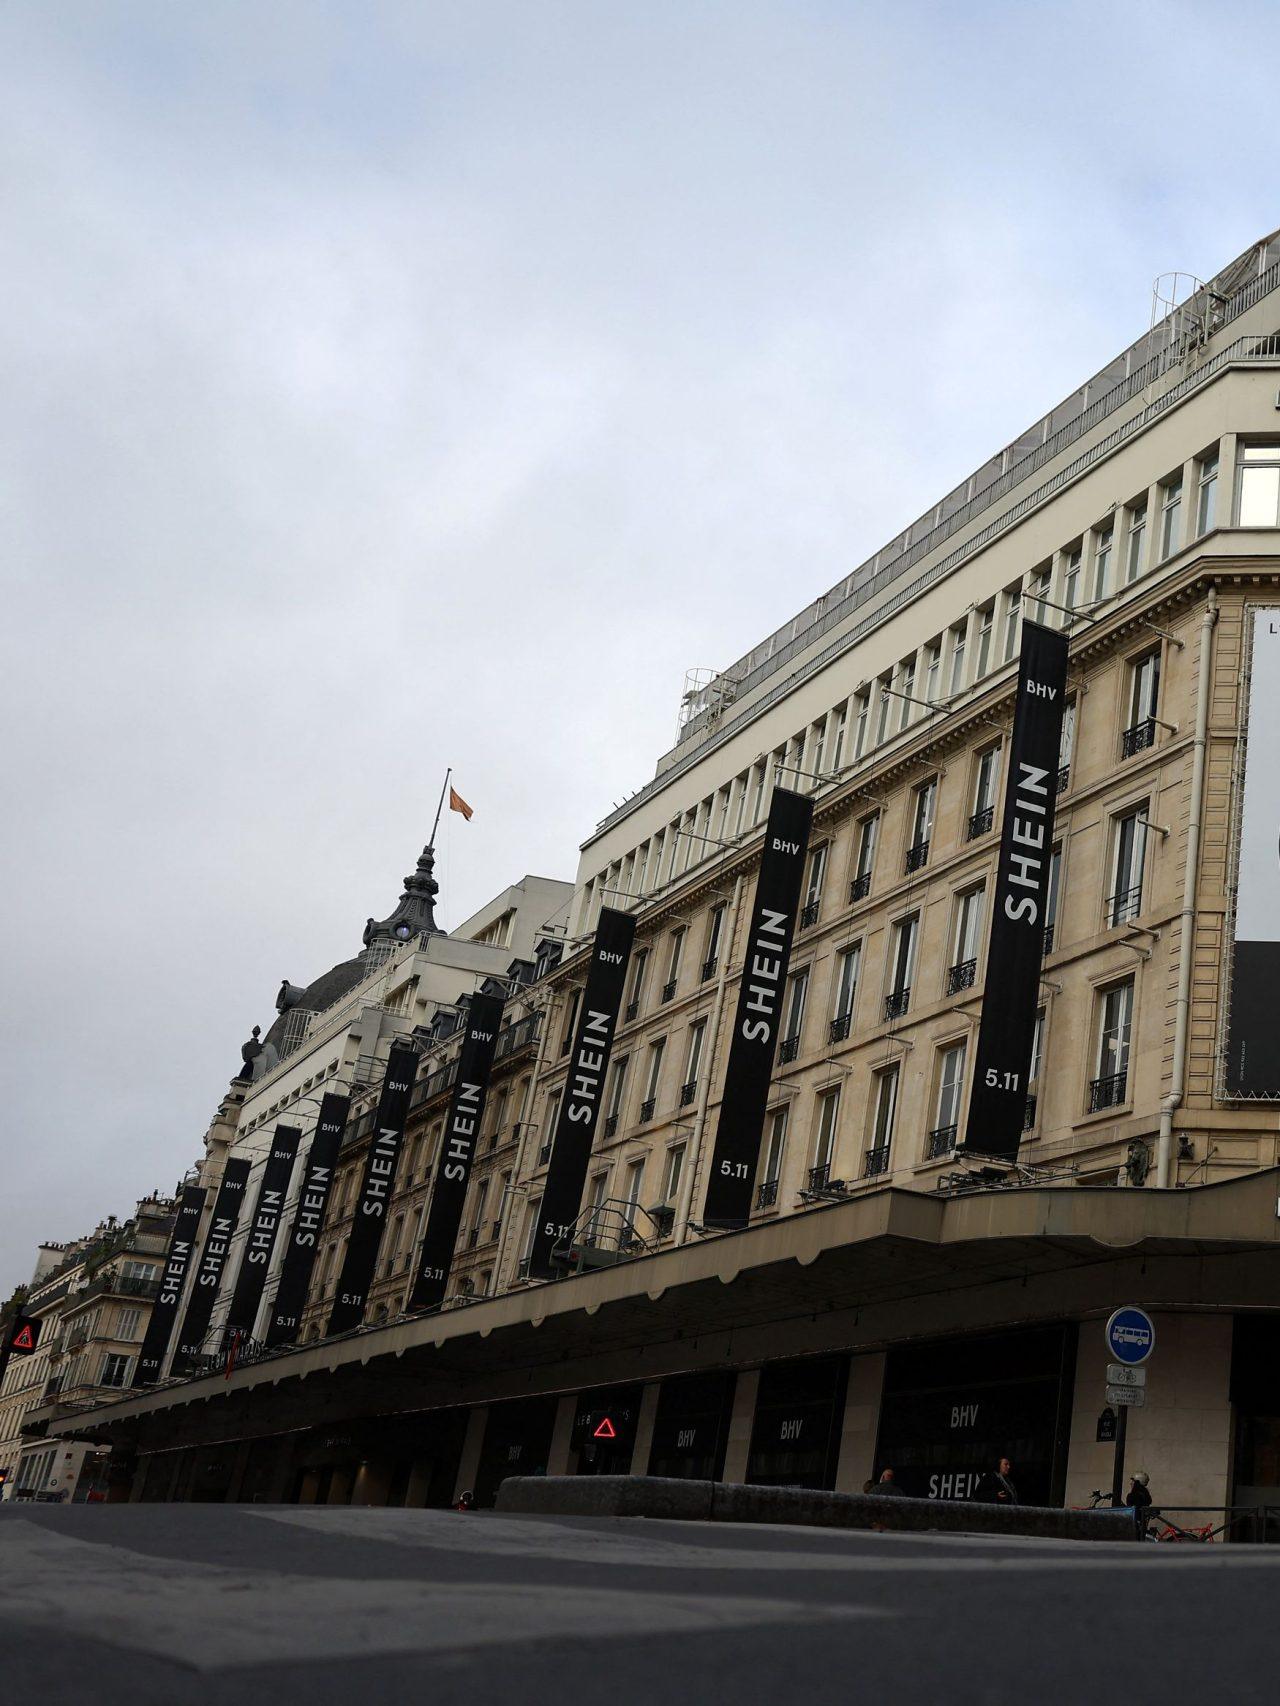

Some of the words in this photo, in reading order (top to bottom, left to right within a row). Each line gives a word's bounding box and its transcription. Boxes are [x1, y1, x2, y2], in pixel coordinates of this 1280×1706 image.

[1026, 678, 1057, 701] BHV
[771, 837, 800, 856] BHV
[1004, 762, 1050, 927] SHEIN
[598, 949, 623, 966] BHV
[741, 908, 789, 1044] SHEIN
[471, 1029, 493, 1043] BHV
[568, 1010, 612, 1124] SHEIN
[388, 1081, 408, 1093] BHV
[985, 1068, 1019, 1092] 5.11
[444, 1082, 481, 1181] SHEIN
[362, 1128, 398, 1216] SHEIN
[720, 1159, 748, 1179] 5.11
[295, 1166, 330, 1247] SHEIN
[248, 1191, 282, 1264] SHEIN
[199, 1218, 233, 1287] SHEIN
[160, 1241, 190, 1305] SHEIN
[423, 1266, 444, 1281] 5.11
[949, 1404, 979, 1429] BHV
[678, 1429, 696, 1447] BHV
[780, 1420, 803, 1440] BHV
